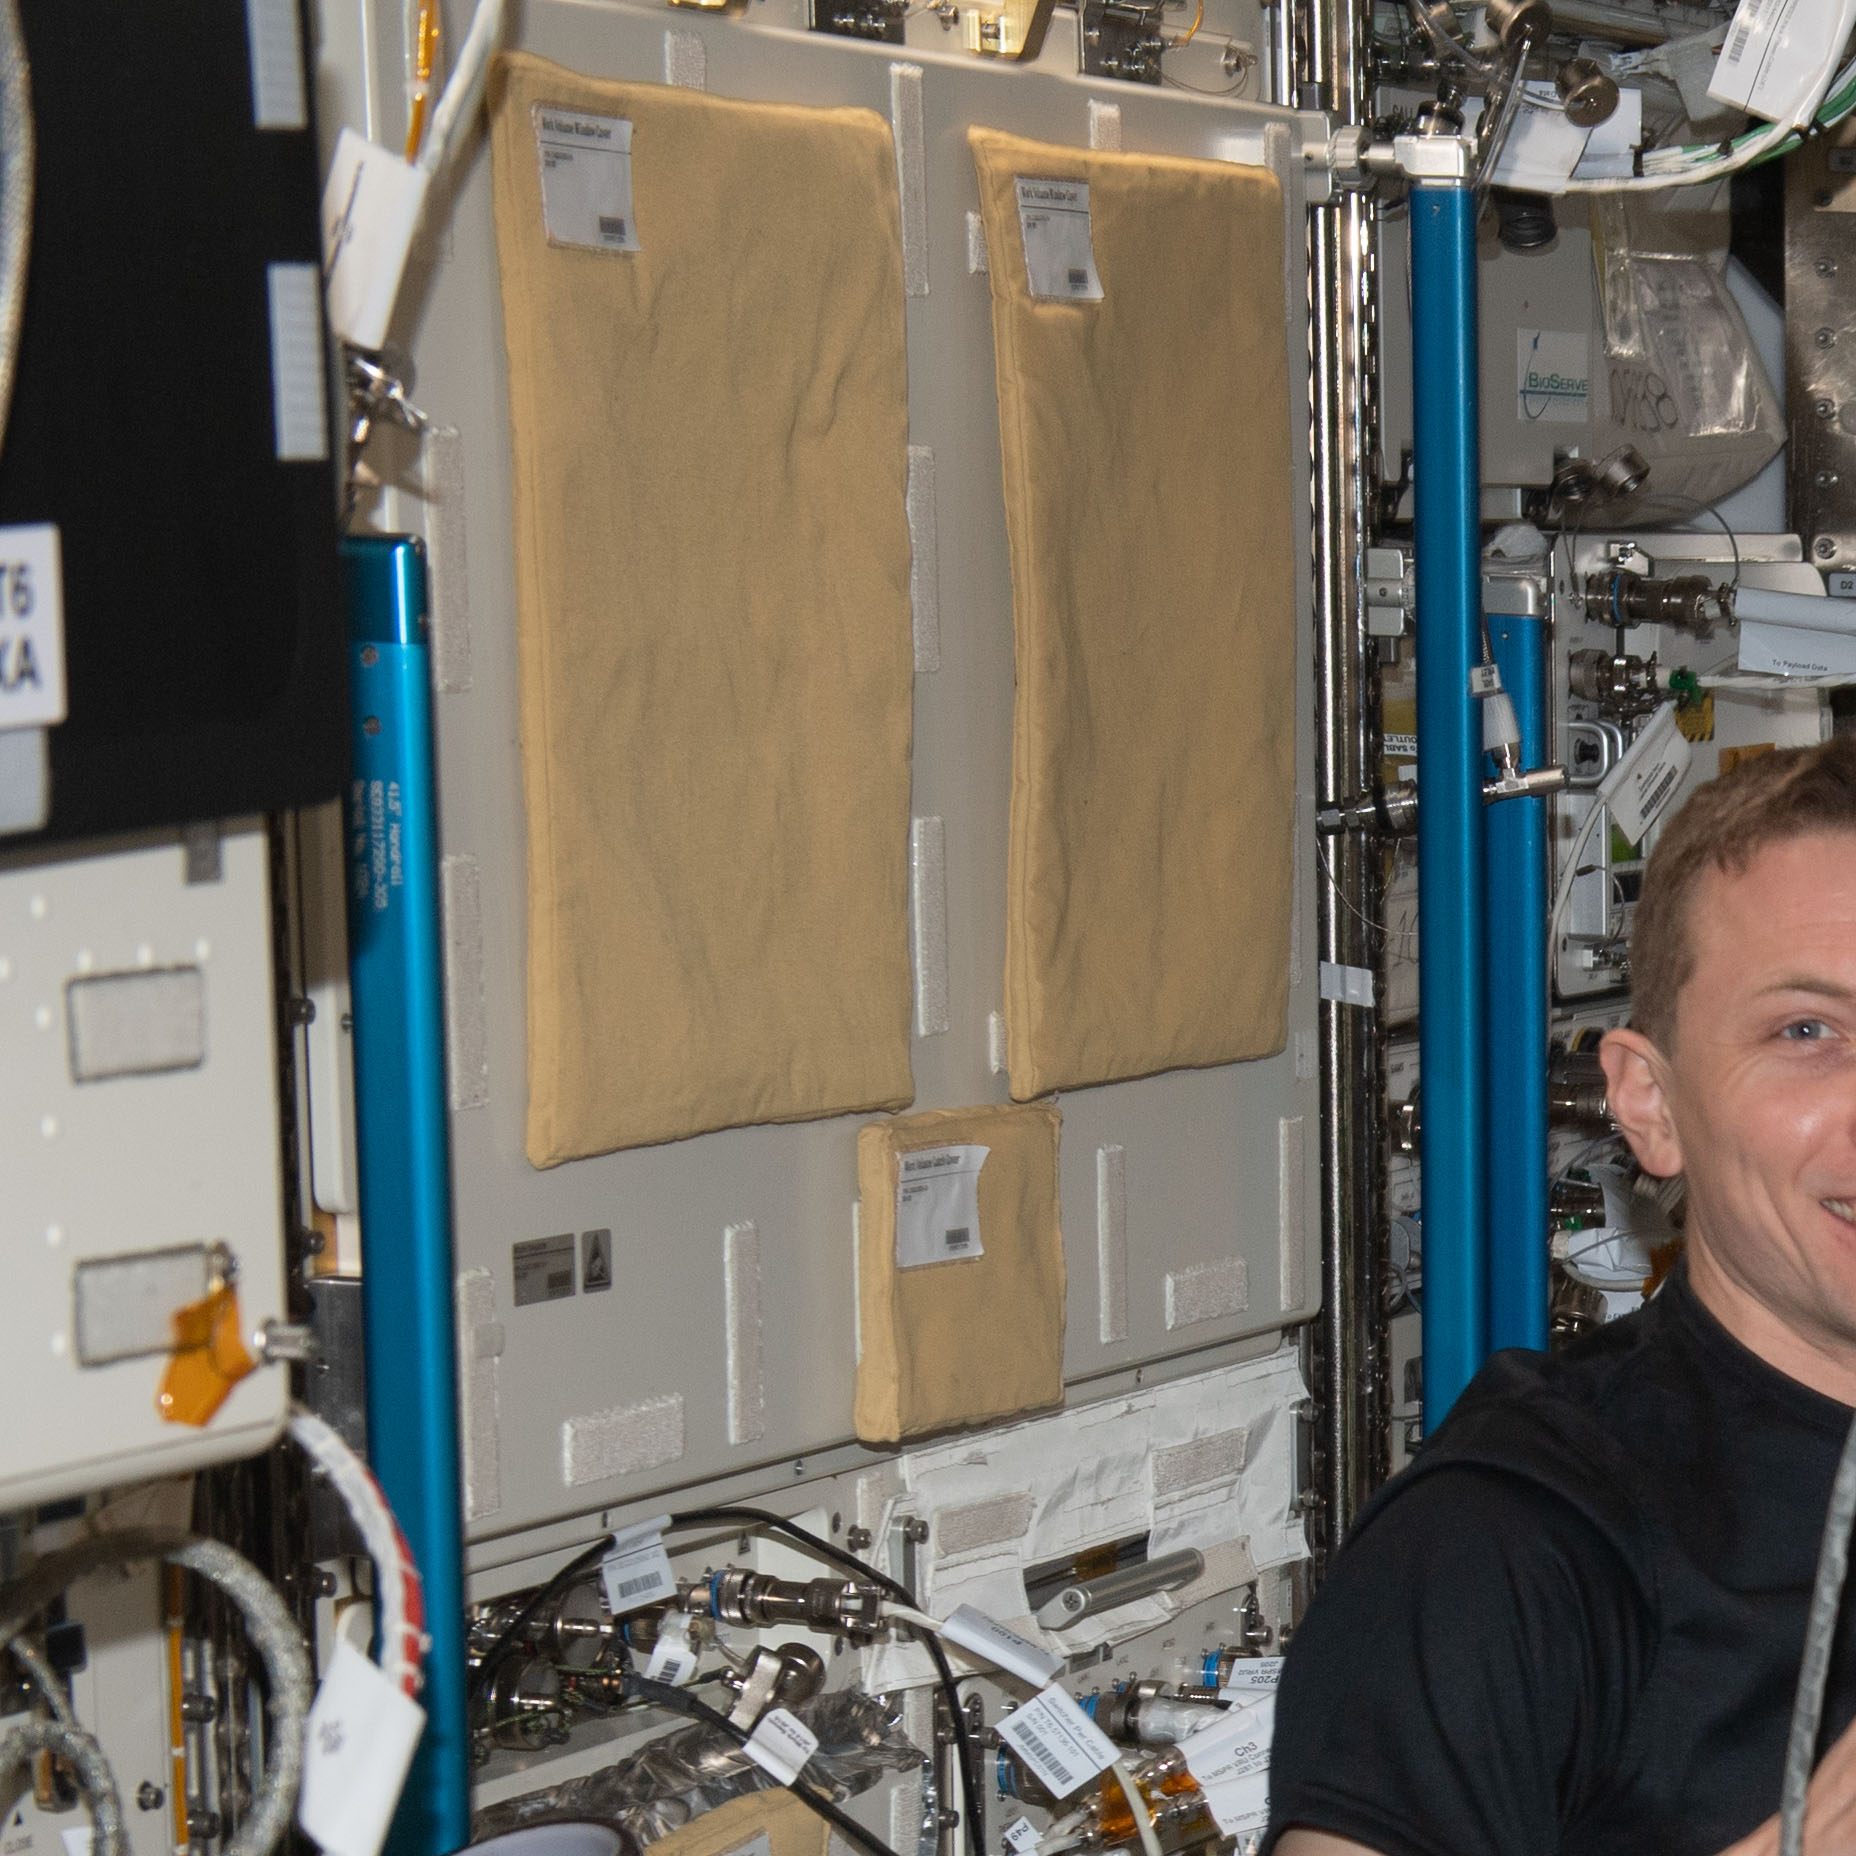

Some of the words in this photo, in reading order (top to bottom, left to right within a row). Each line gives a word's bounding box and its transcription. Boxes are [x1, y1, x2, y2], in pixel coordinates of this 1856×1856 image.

[1840, 580, 1854, 590] D2
[1772, 658, 1782, 667] To
[1783, 659, 1810, 672] Payload
[1811, 663, 1828, 672] Data
[1249, 1675, 1278, 1683] P205
[1233, 1739, 1259, 1759] Ch3
[1010, 1822, 1029, 1842] P49
